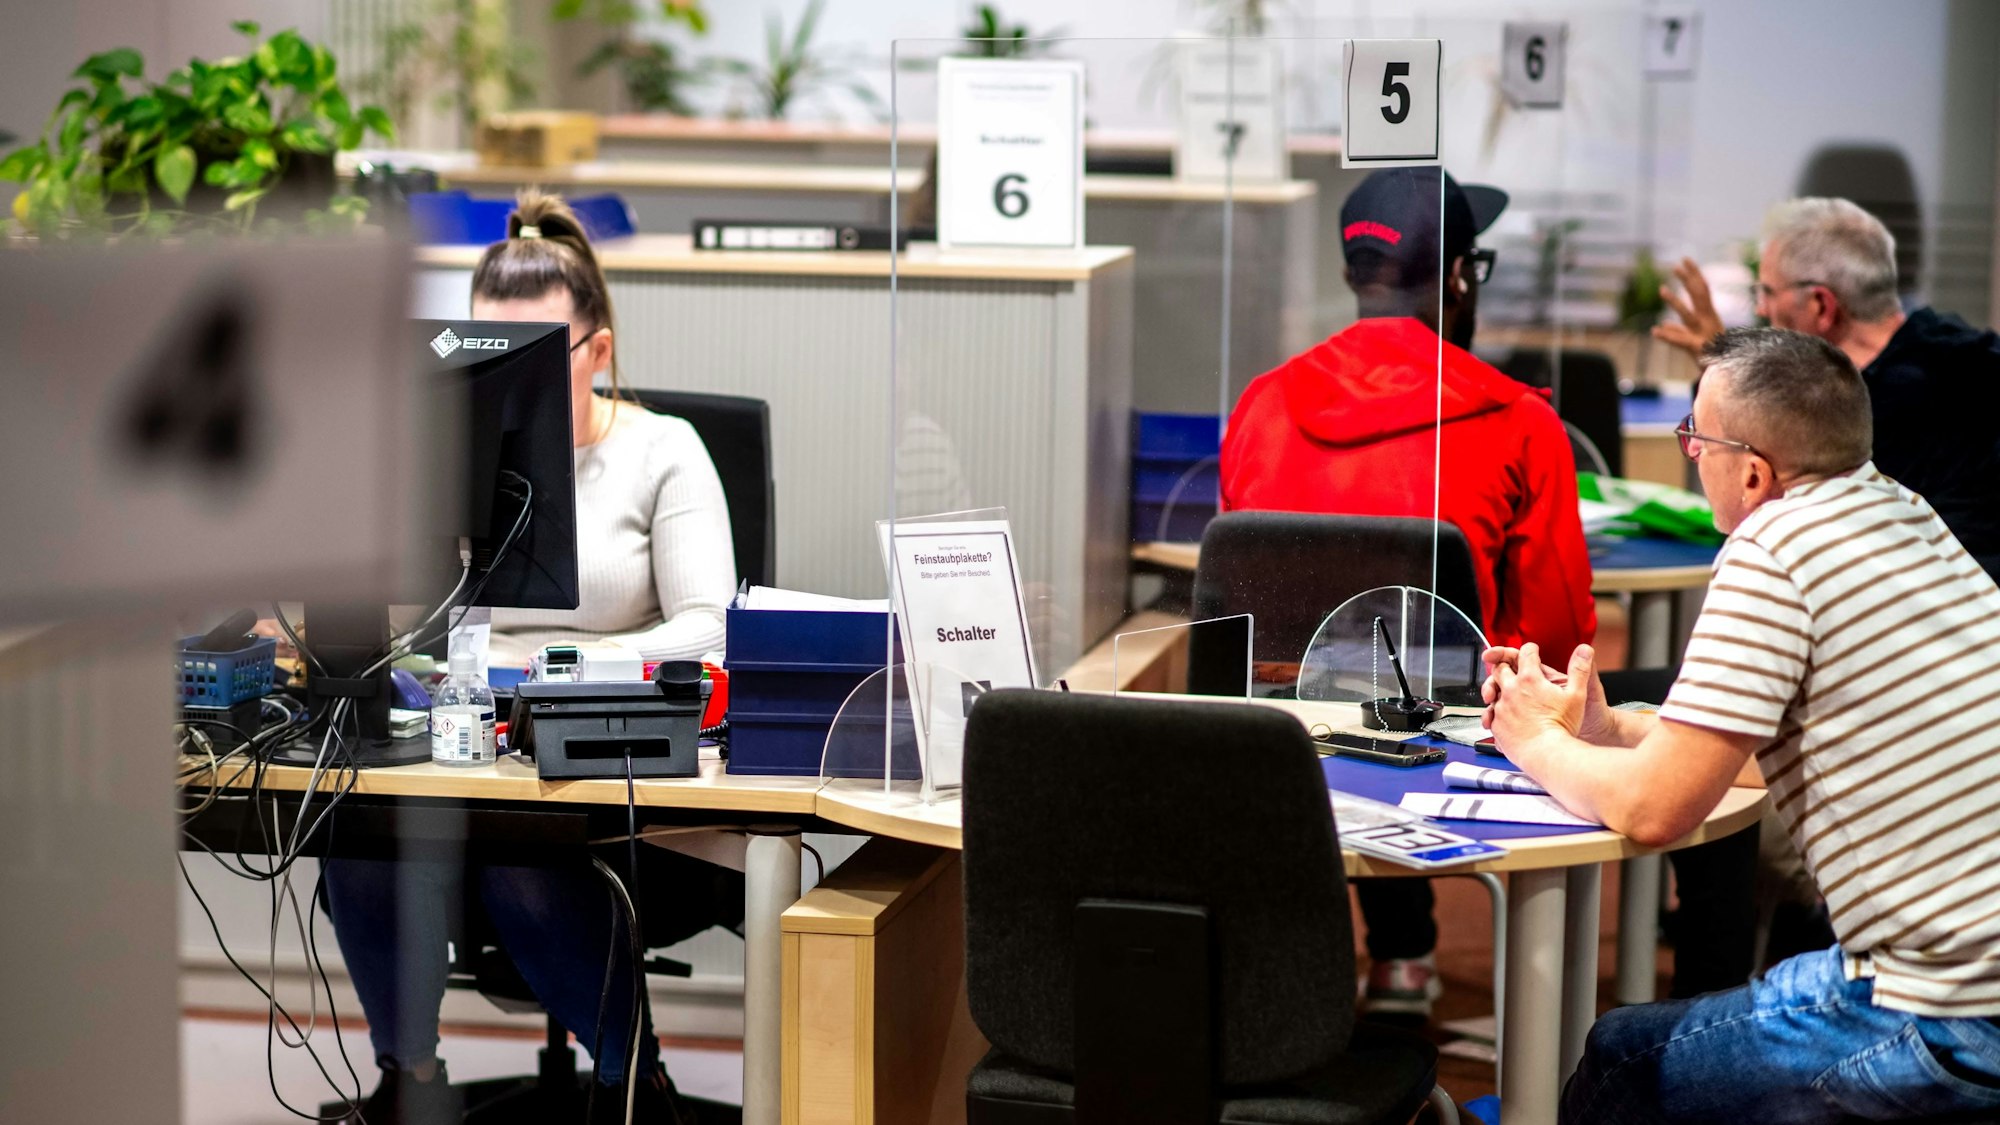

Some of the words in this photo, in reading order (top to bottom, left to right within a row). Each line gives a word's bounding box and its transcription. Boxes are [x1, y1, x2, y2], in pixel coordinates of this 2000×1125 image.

[1662, 17, 1682, 57] 7
[1524, 35, 1545, 83] 6
[1380, 62, 1411, 124] 5
[1215, 121, 1246, 161] 7
[993, 174, 1030, 218] 6
[462, 338, 509, 350] EIZO
[115, 285, 262, 480] 4
[914, 552, 992, 565] Feinstaubplakette?
[934, 571, 949, 579] geben
[936, 626, 996, 642] Schalter
